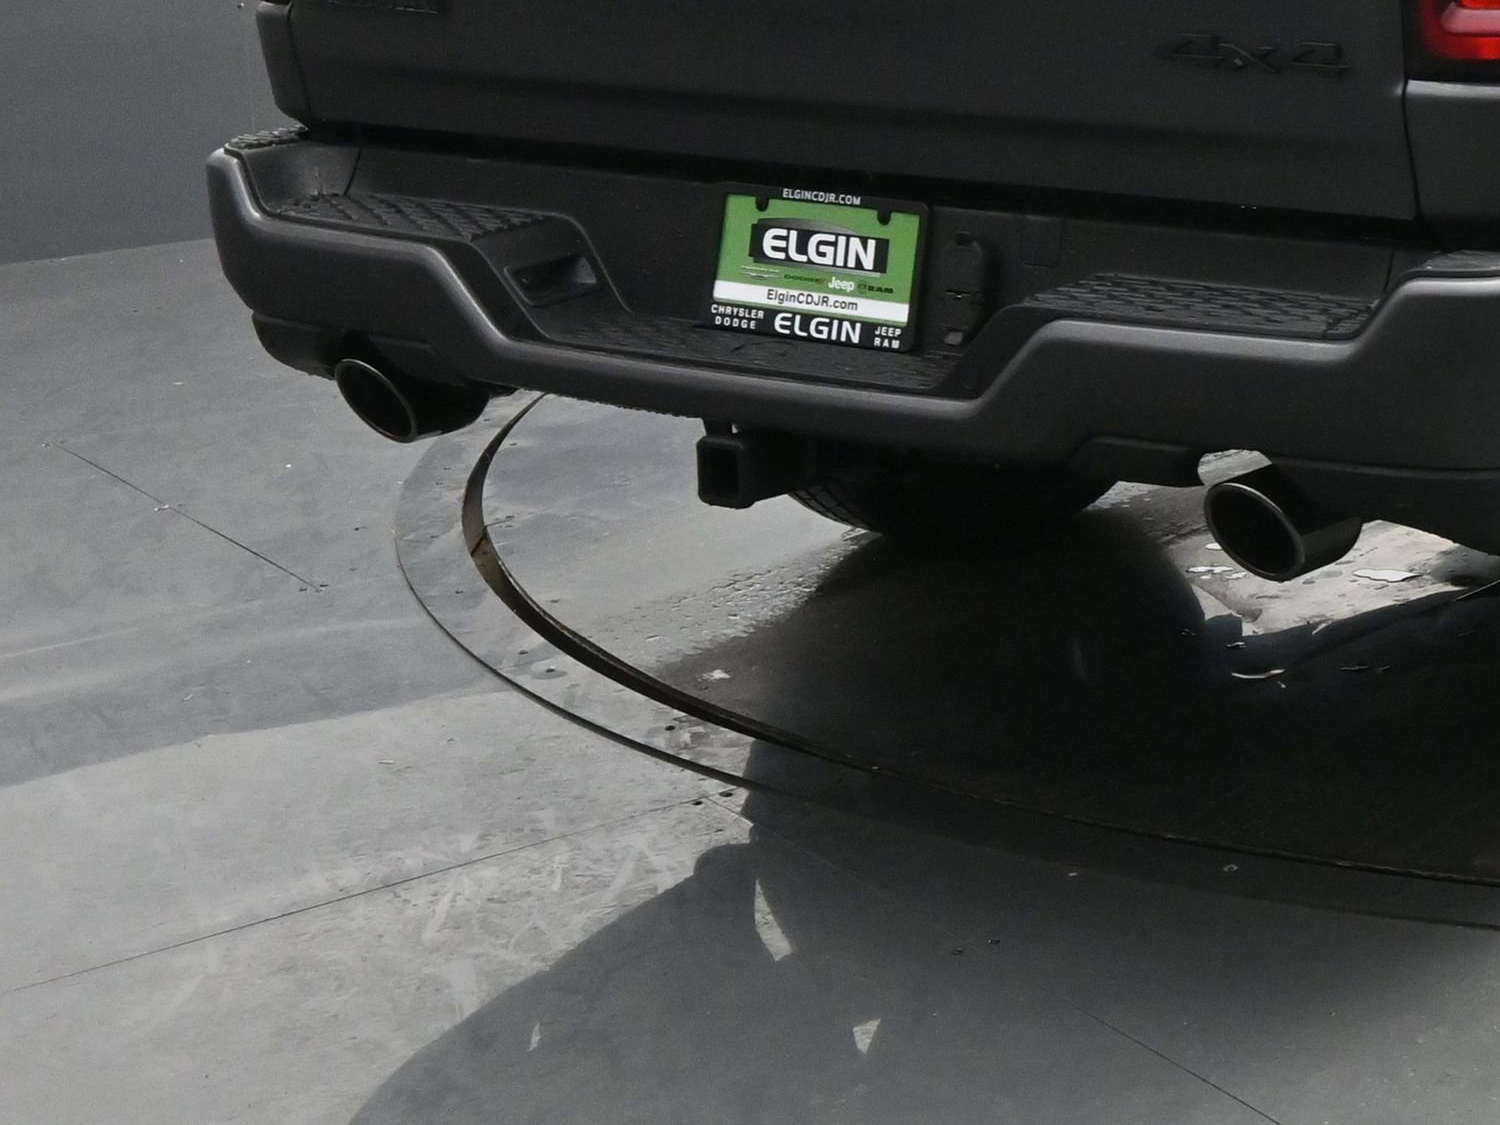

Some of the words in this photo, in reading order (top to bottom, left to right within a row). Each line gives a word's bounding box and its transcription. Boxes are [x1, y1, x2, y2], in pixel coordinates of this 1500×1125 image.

[782, 188, 861, 205] ELGINCDJR.COM
[762, 227, 876, 270] ELGIN
[828, 276, 855, 292] Jeep
[868, 285, 894, 294] RAM
[767, 289, 858, 311] ElginCDJR.com
[711, 304, 764, 319] CHRYSLER
[715, 316, 757, 330] DODGE
[774, 312, 861, 344] ELGIN
[875, 326, 902, 337] JEEP
[874, 337, 900, 349] RAM
